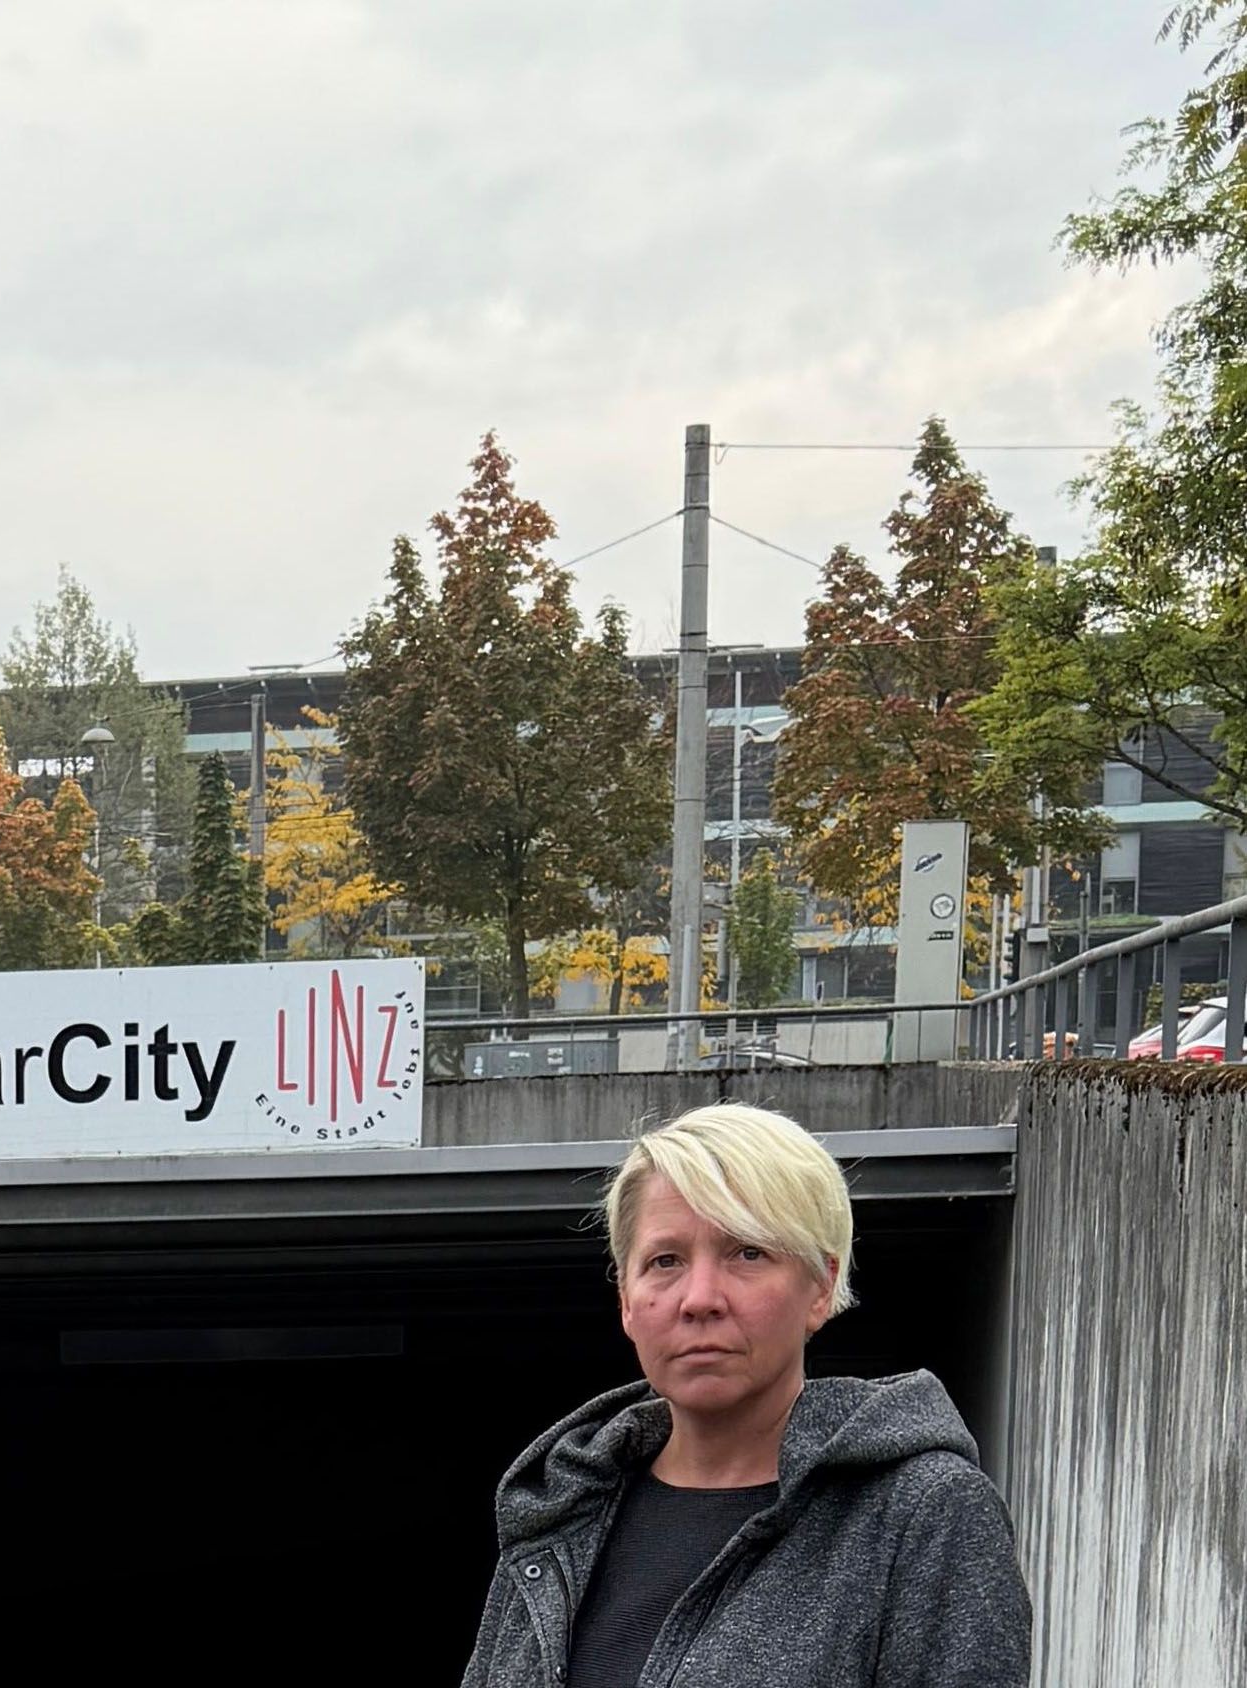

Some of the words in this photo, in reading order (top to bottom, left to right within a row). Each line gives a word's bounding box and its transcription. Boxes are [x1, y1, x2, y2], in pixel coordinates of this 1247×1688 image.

[276, 969, 399, 1122] LINZ
[254, 1092, 301, 1136] Eine
[315, 1108, 387, 1140] Stadt
